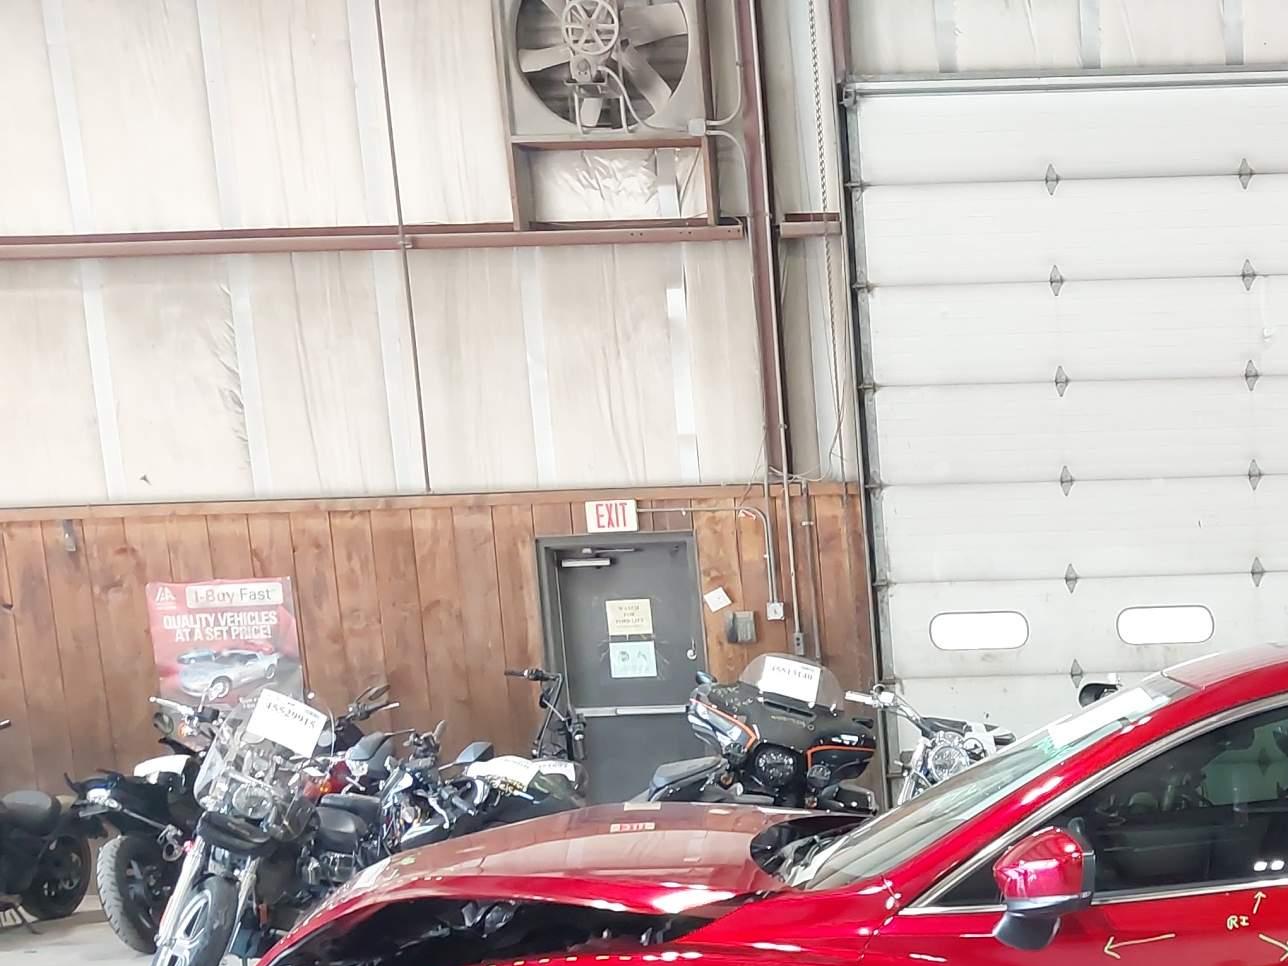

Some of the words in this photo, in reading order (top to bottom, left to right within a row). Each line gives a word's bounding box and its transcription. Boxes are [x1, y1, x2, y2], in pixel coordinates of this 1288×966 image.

[595, 502, 628, 528] EXIT
[194, 588, 235, 603] I-Buy
[239, 587, 272, 601] Fast
[163, 612, 217, 630] QUALITY
[217, 611, 278, 627] VEHICLES
[175, 628, 192, 642] AT
[193, 628, 203, 641] A
[205, 626, 229, 641] SET
[231, 624, 272, 640] PRICE!
[1227, 915, 1249, 930] RI
